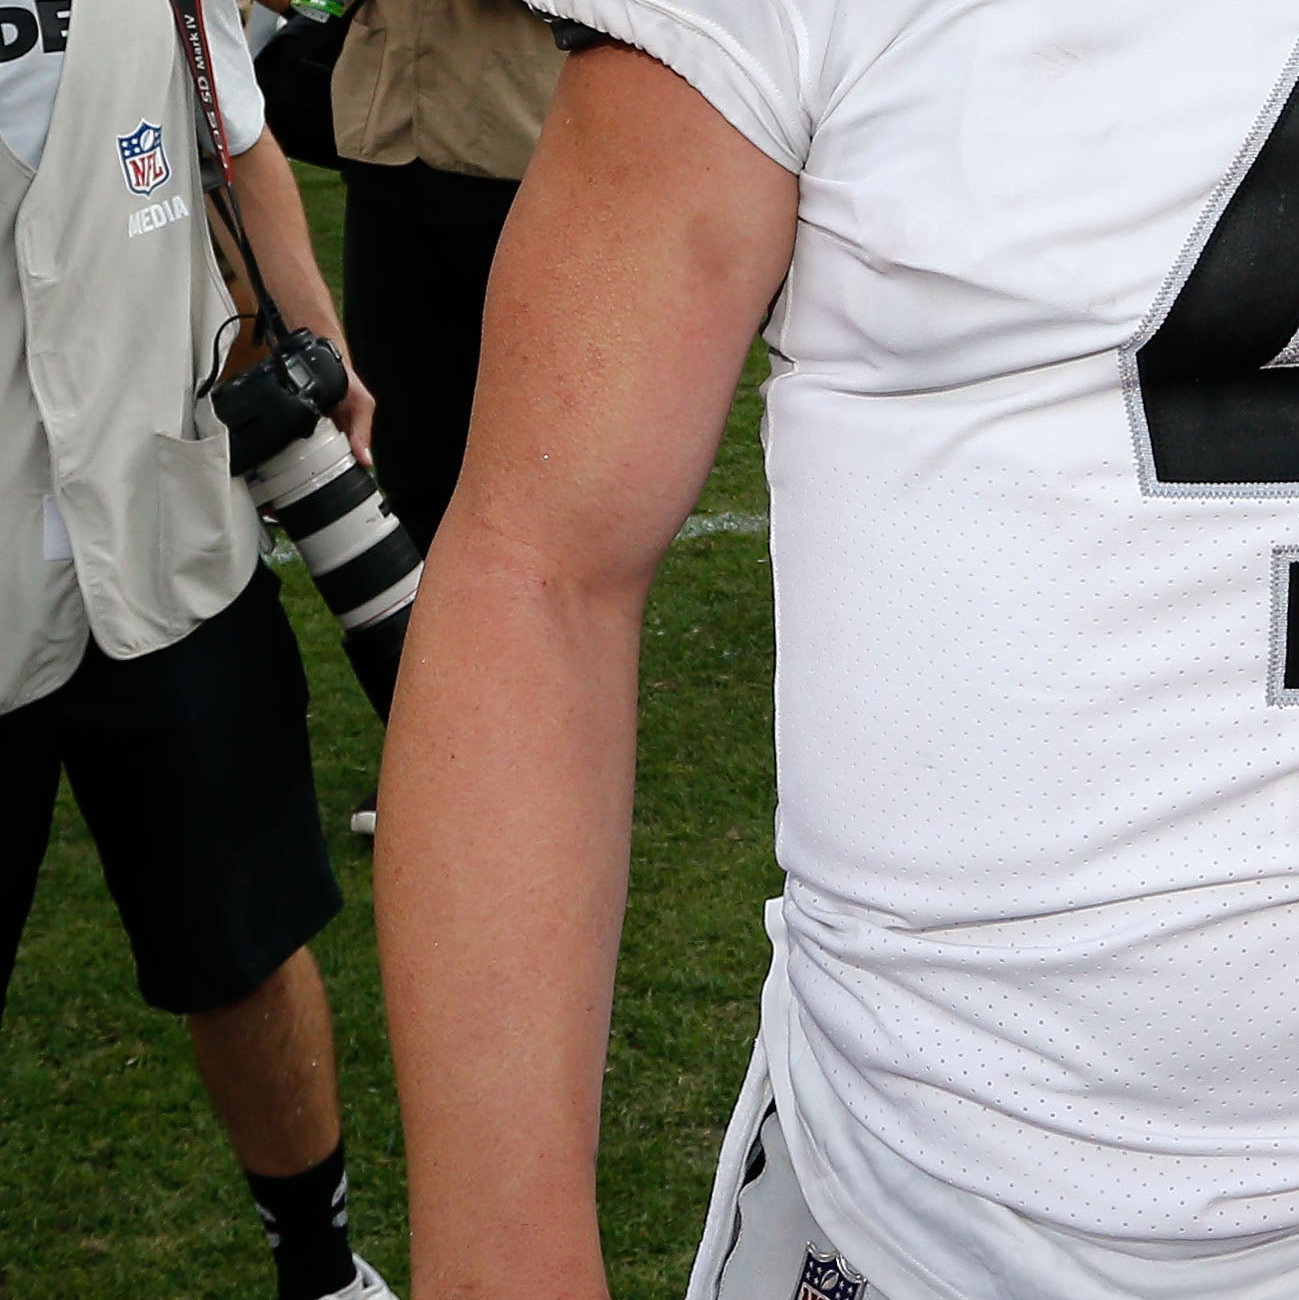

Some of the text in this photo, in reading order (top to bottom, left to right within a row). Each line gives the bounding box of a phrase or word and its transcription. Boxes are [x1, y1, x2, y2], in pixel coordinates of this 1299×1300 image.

[183, 14, 196, 28] IV
[188, 30, 206, 70] Mark
[129, 152, 165, 188] NFL
[127, 195, 190, 239] MEDIA
